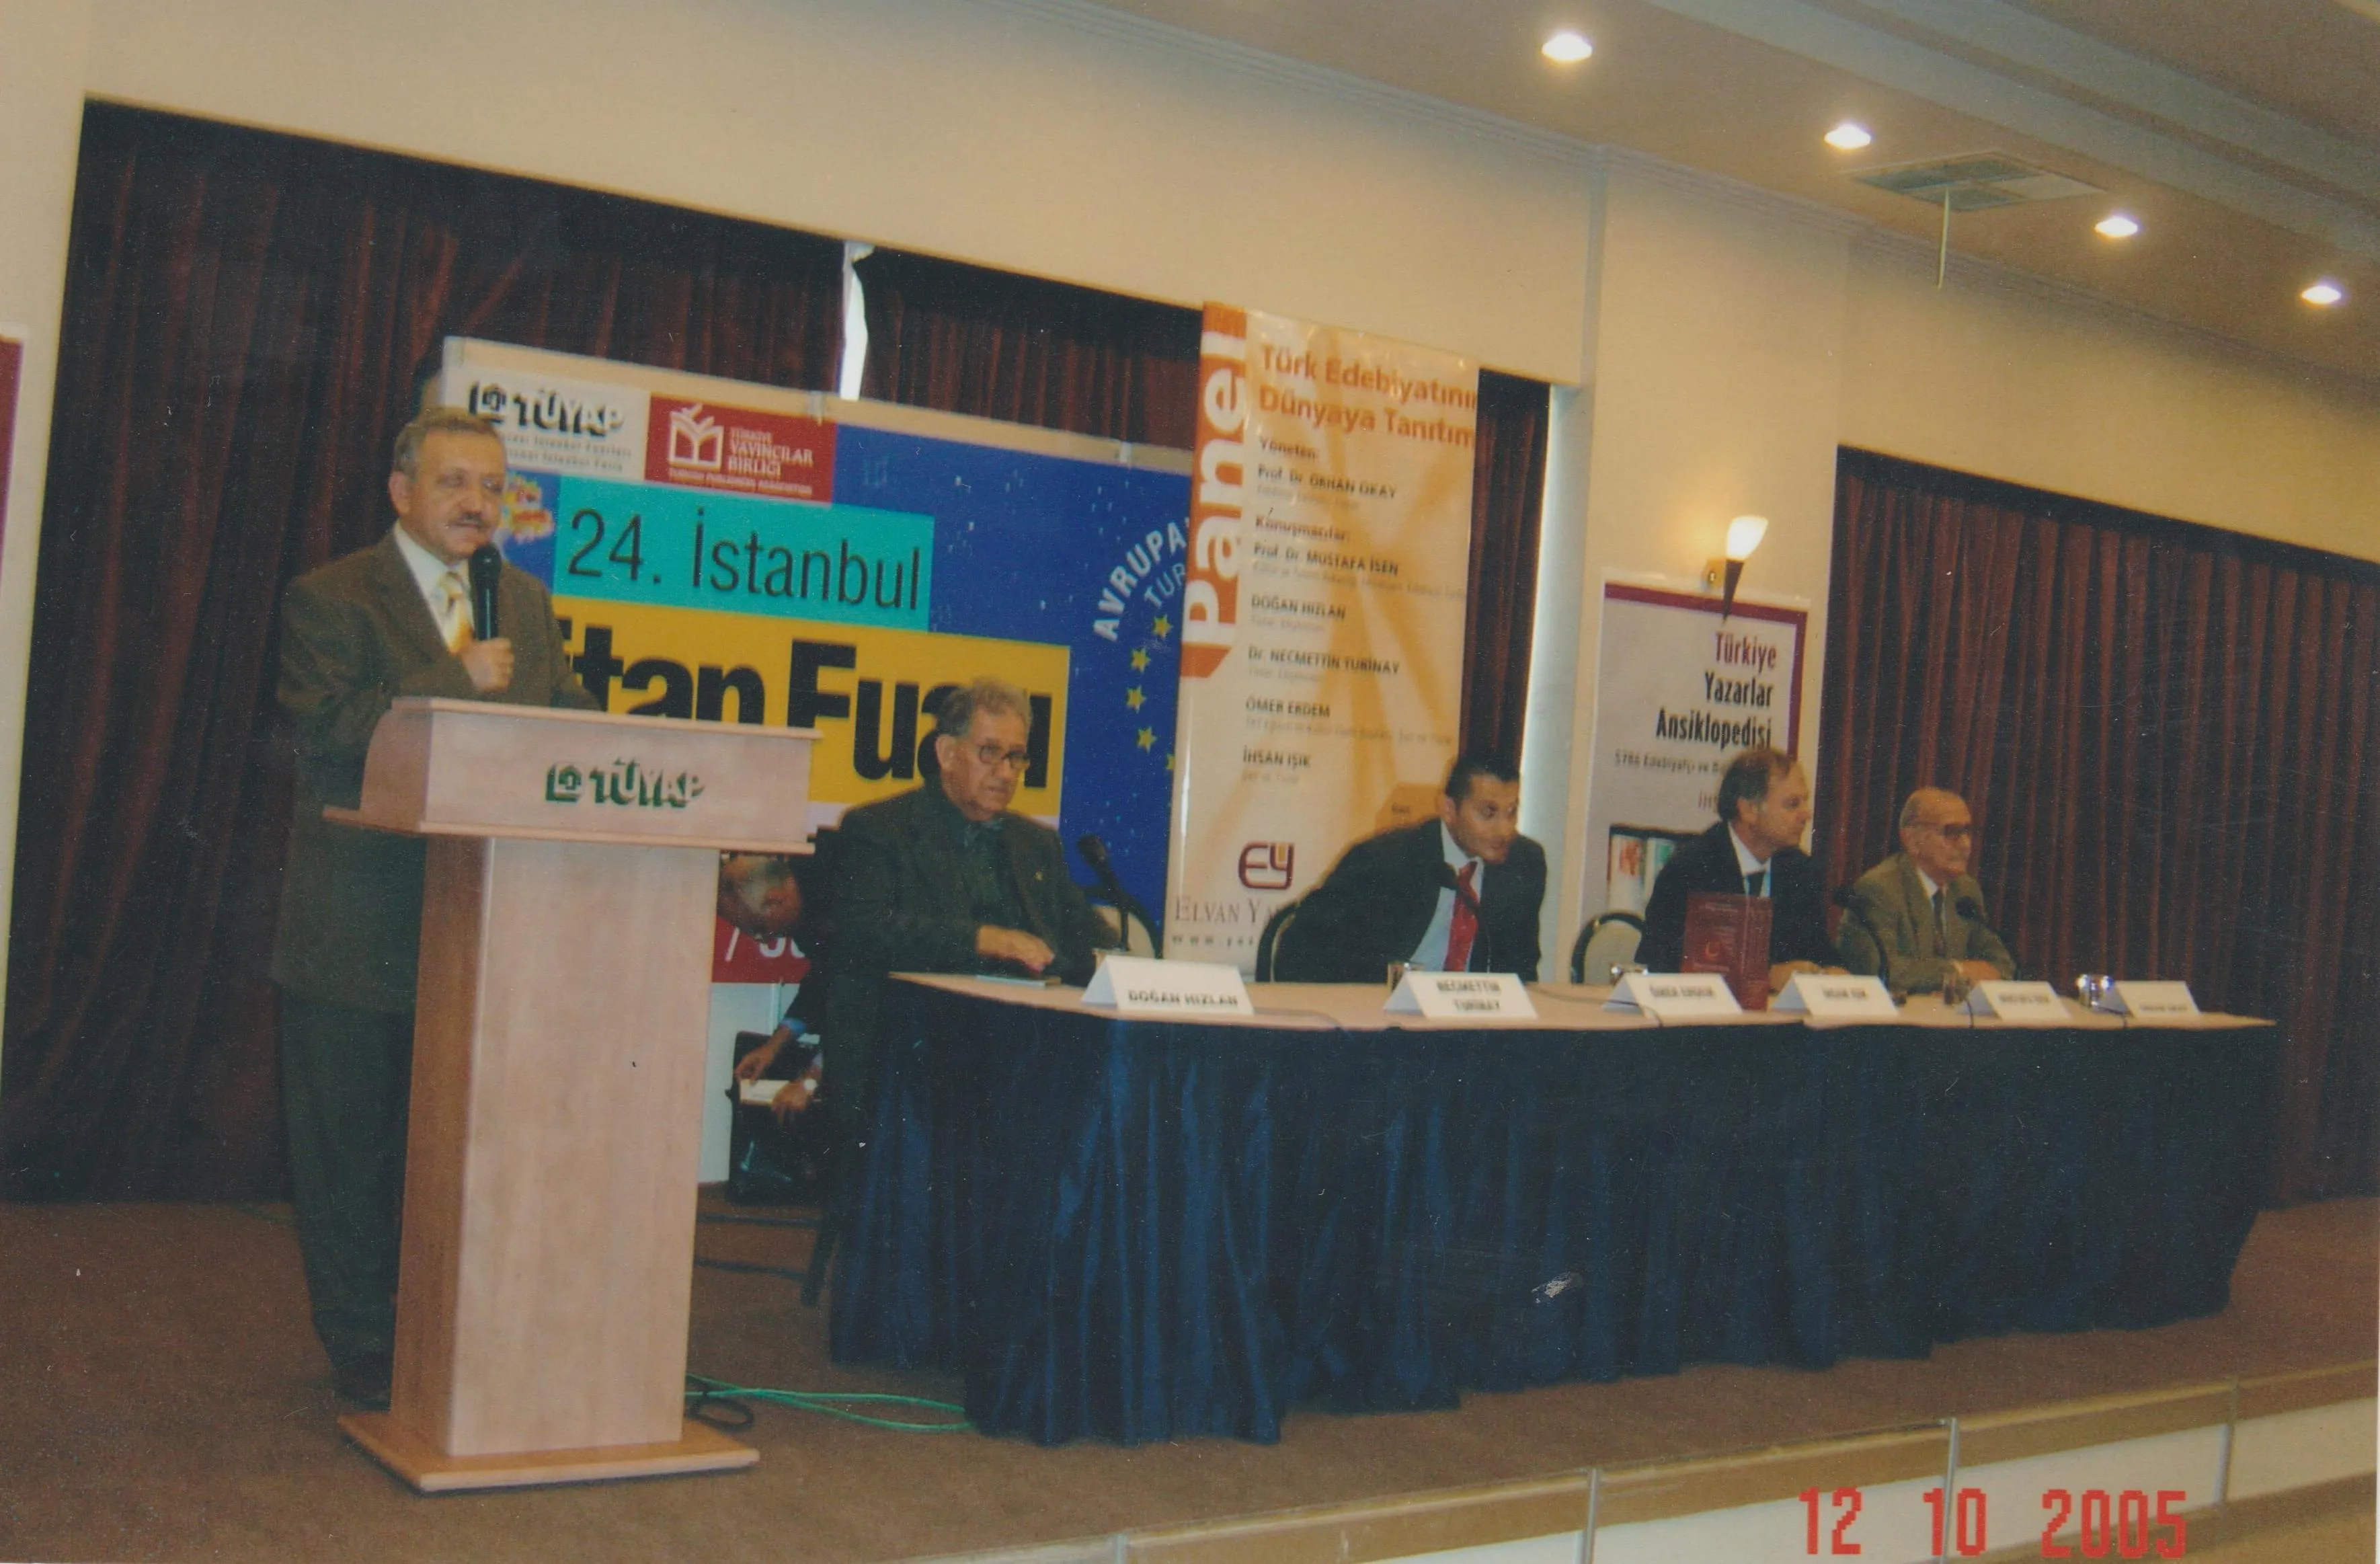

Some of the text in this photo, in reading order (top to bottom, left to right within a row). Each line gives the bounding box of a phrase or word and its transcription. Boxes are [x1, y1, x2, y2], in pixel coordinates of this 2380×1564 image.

[1260, 344, 1316, 381] Türk
[1259, 384, 1376, 434] Dünyaya
[1181, 331, 1246, 644] Panel
[567, 507, 921, 611] 24. İstanbul
[1306, 551, 1366, 572] MUSTAFA
[1251, 594, 1298, 613] DOĞAN
[1715, 631, 1777, 673] Türkiye
[1246, 696, 1331, 718] ÖMER ERDEM
[1704, 670, 1774, 707] Yazarlar
[1656, 706, 1772, 751] Ansiklopedisi
[1243, 746, 1283, 765] İHSAN
[1128, 988, 1238, 1006] DOĞAN HIZLAN
